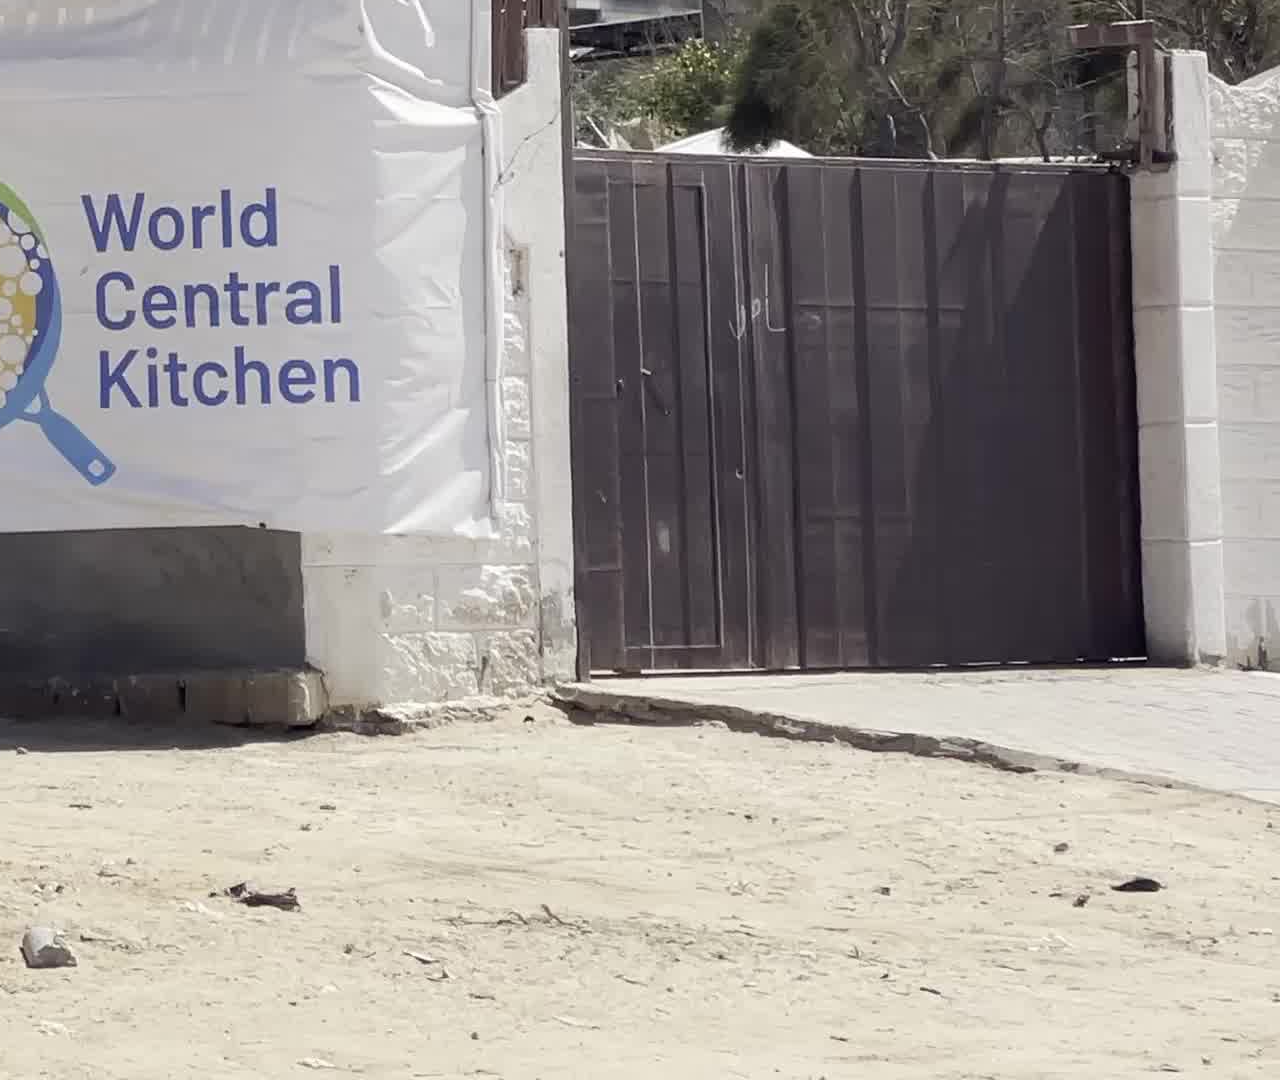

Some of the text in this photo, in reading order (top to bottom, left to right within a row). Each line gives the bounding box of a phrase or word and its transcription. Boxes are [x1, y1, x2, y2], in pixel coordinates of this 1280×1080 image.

[81, 186, 279, 253] World
[95, 263, 343, 331] Central
[98, 344, 362, 410] Kitchen
